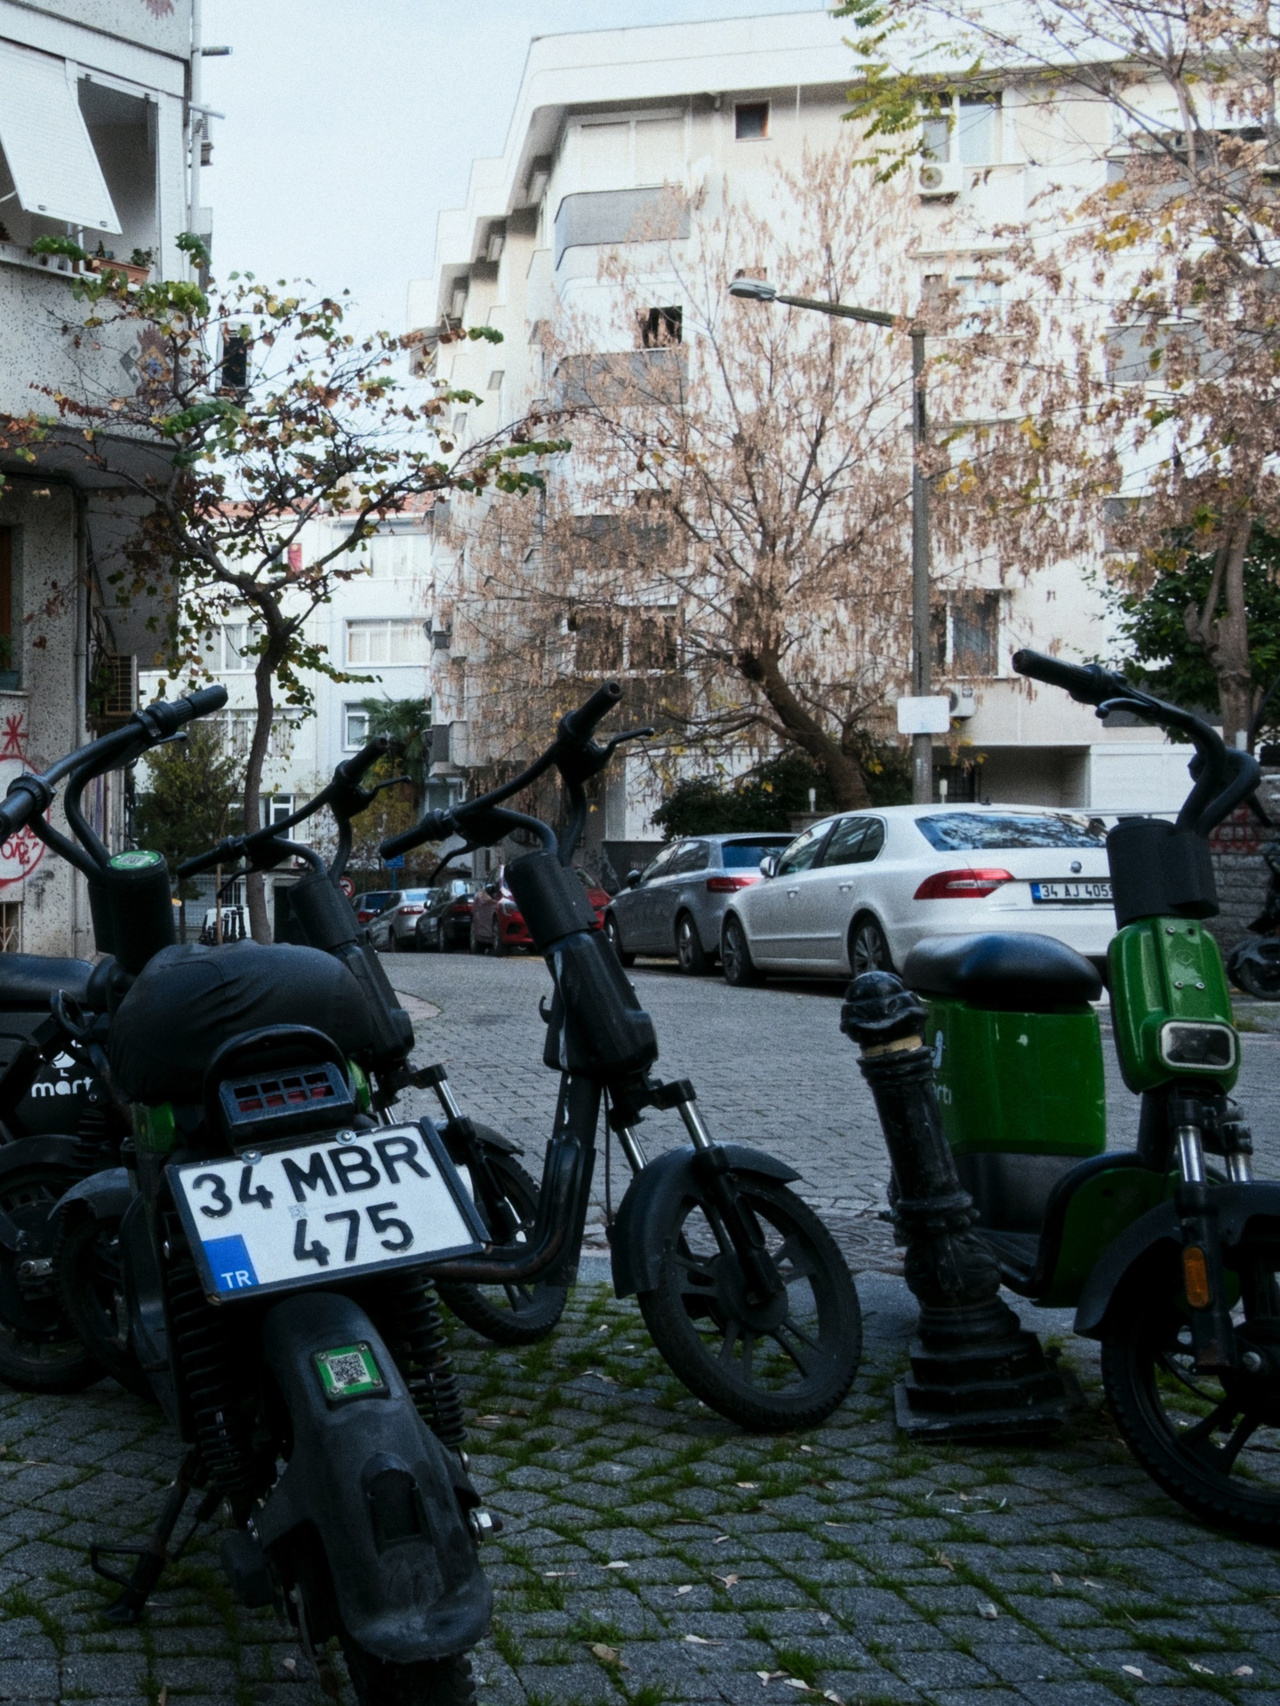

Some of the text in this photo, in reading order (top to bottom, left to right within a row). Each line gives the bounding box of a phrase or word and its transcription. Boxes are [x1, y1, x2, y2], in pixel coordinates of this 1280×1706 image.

[1041, 884, 1058, 897] 34
[1064, 884, 1080, 897] AJ
[192, 1136, 431, 1219] 34 MBR
[293, 1201, 414, 1267] 475
[220, 1270, 252, 1289] TR
